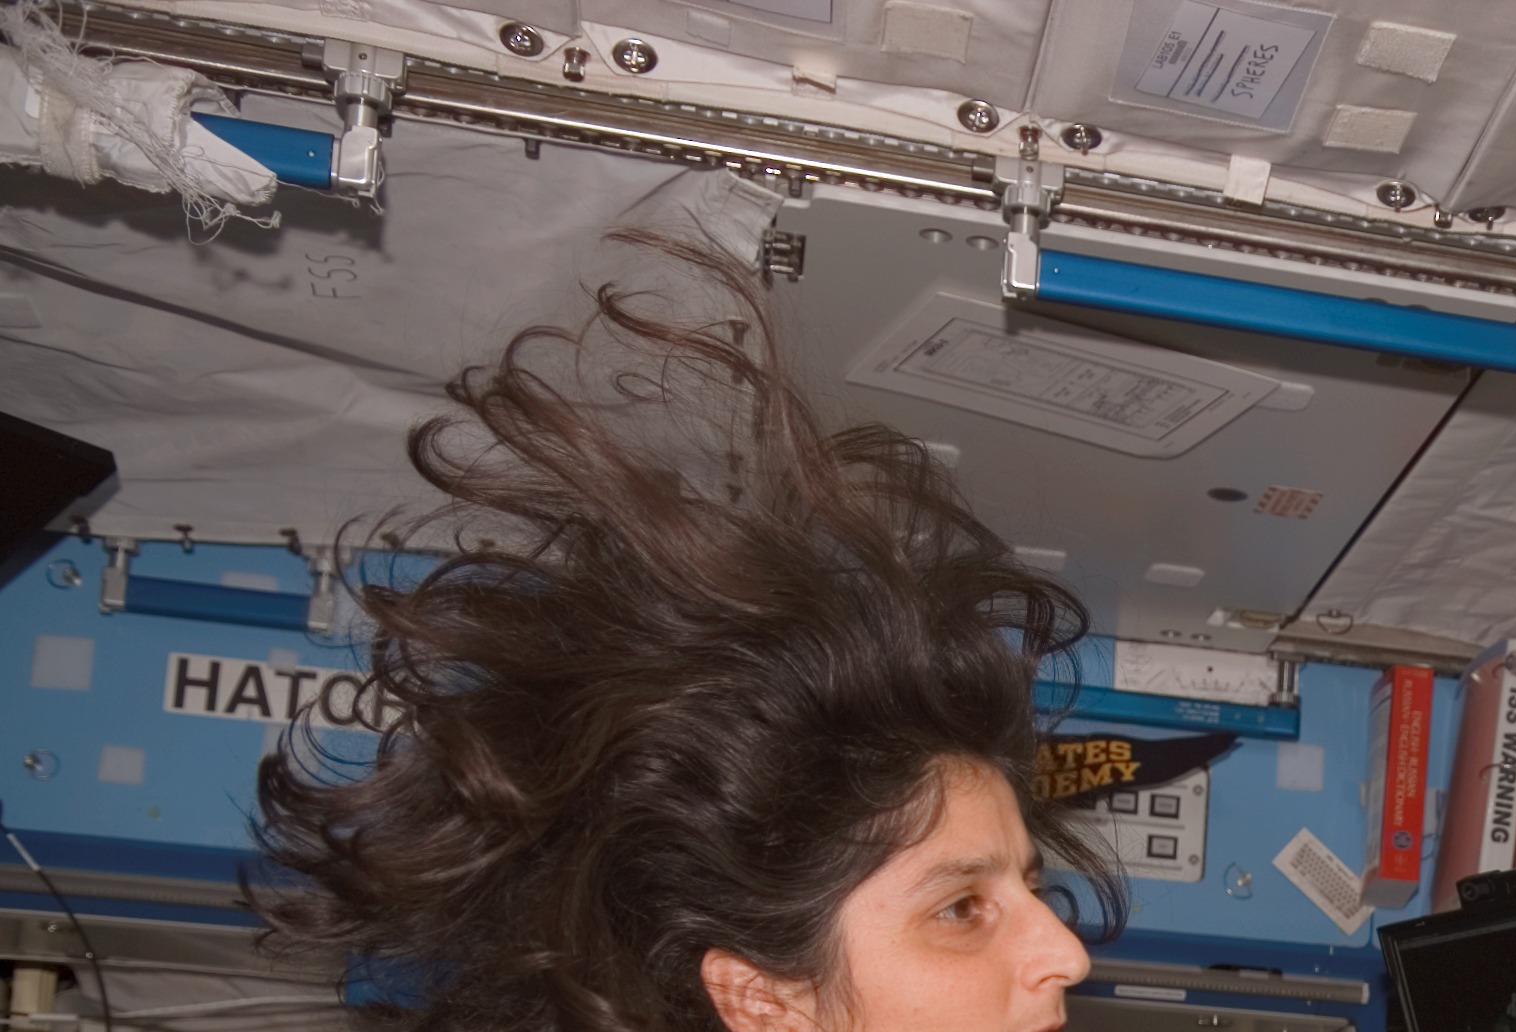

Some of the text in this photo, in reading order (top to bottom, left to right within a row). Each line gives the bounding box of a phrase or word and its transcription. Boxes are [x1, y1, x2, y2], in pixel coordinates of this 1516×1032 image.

[1231, 44, 1278, 99] SPHERES
[1036, 740, 1132, 770] ATES
[1033, 762, 1140, 798] DEMY
